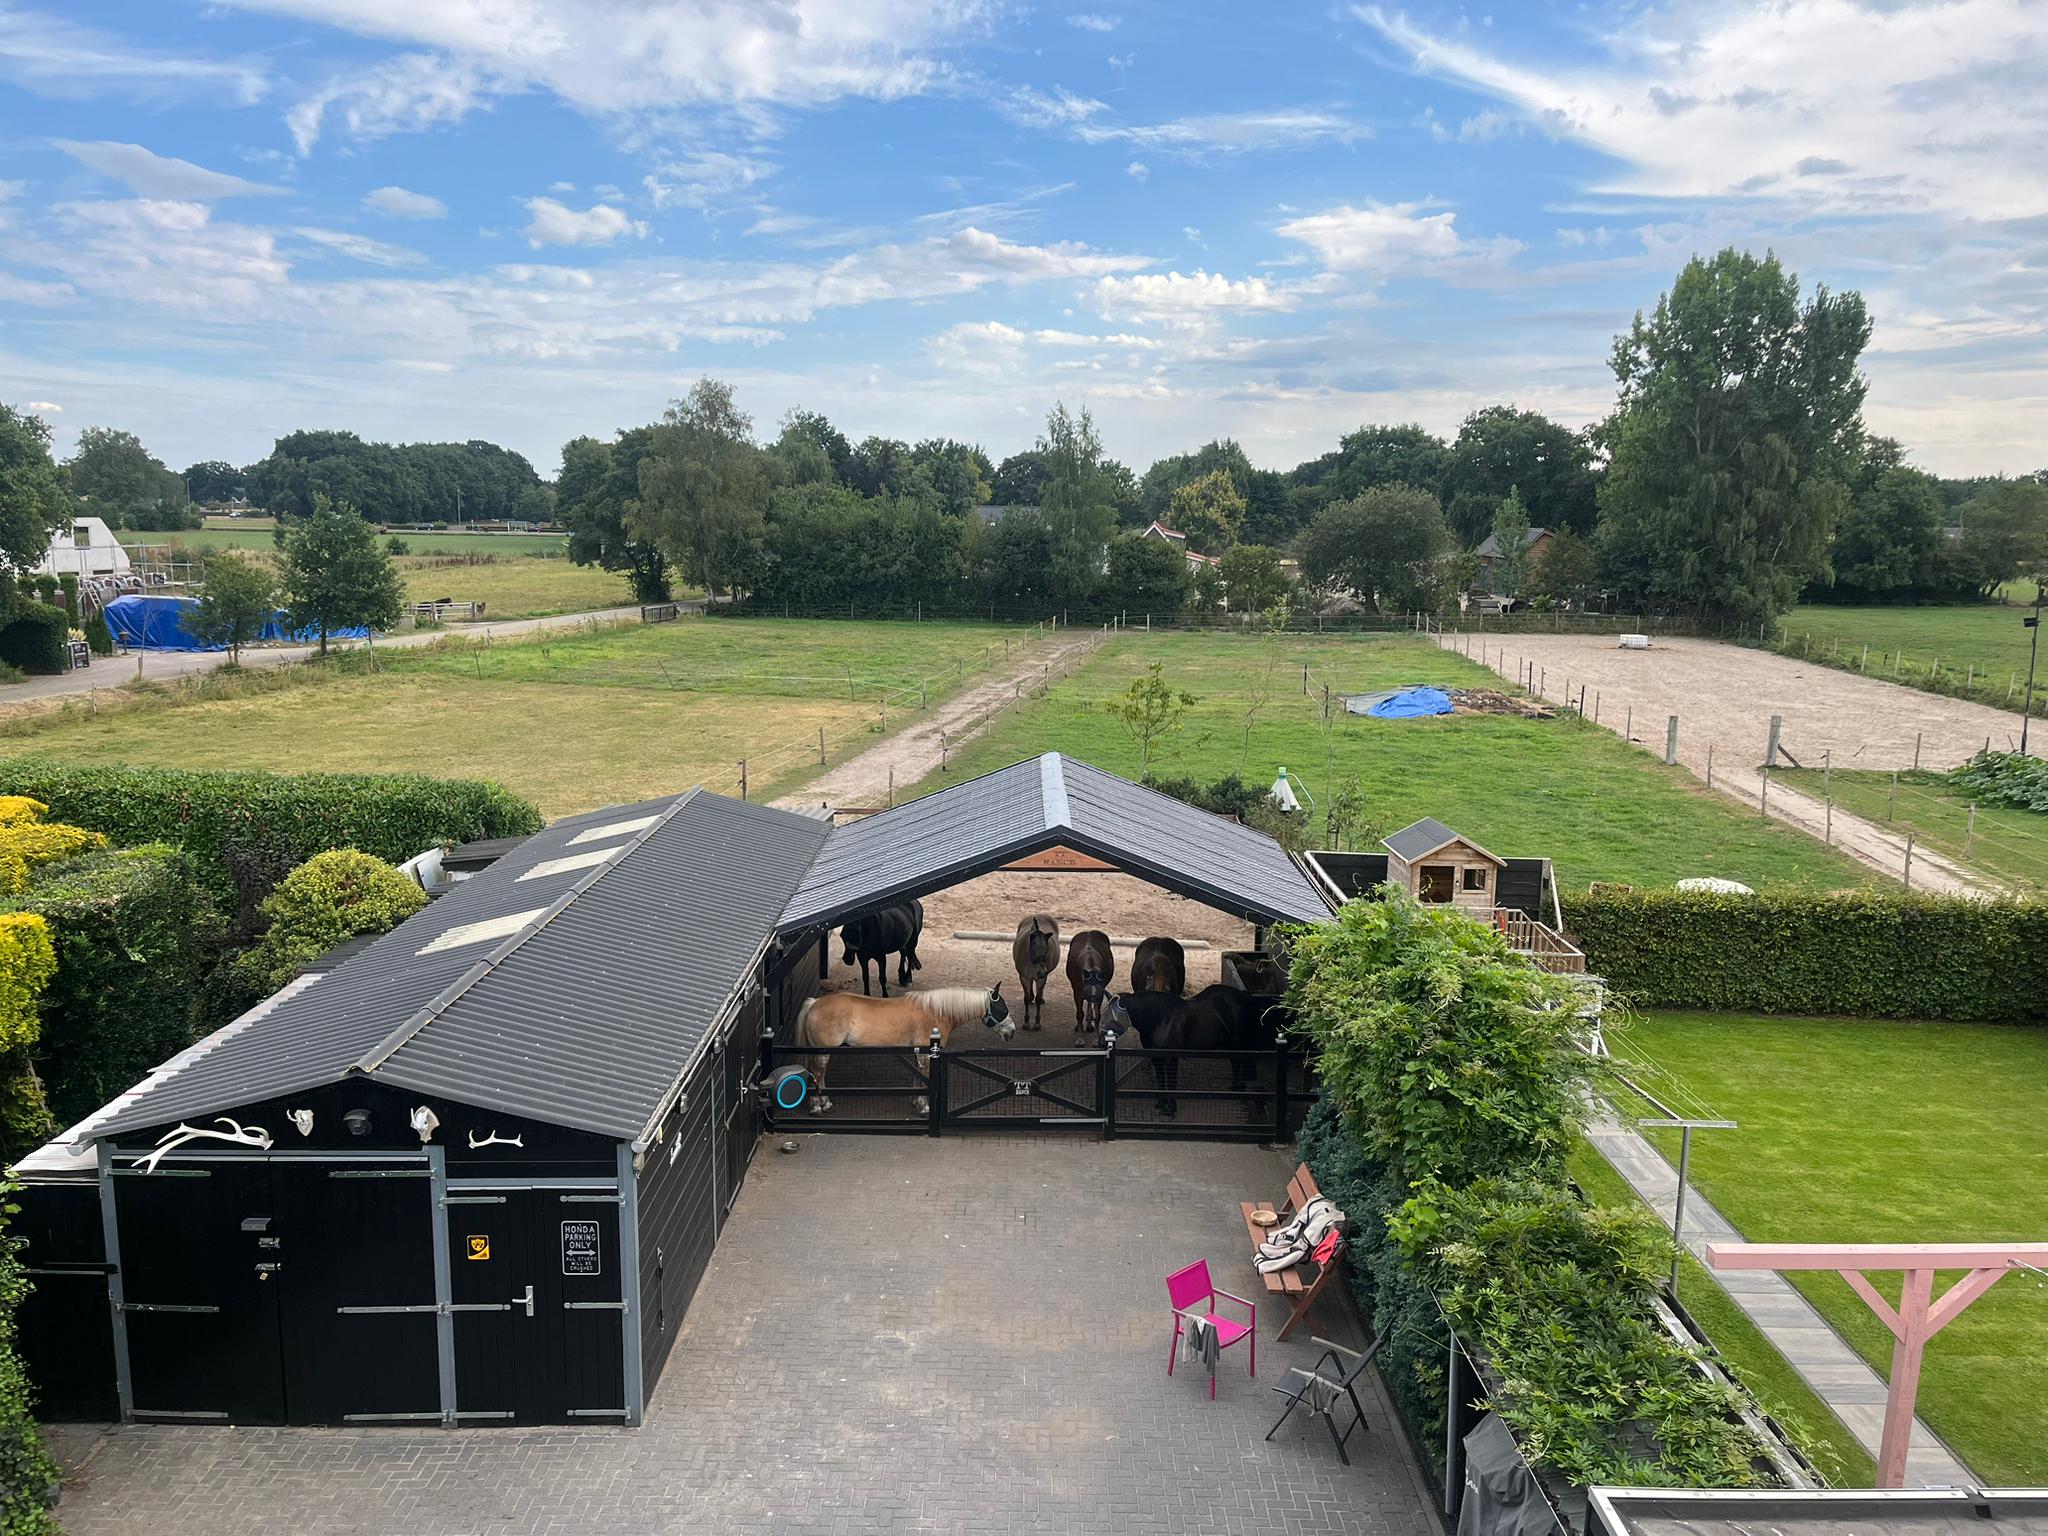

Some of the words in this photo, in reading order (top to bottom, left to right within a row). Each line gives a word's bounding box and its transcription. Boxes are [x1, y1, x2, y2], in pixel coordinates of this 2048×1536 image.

[564, 1225, 595, 1233] HONDA
[564, 1233, 596, 1241] PARKING
[569, 1241, 592, 1249] ONLY
